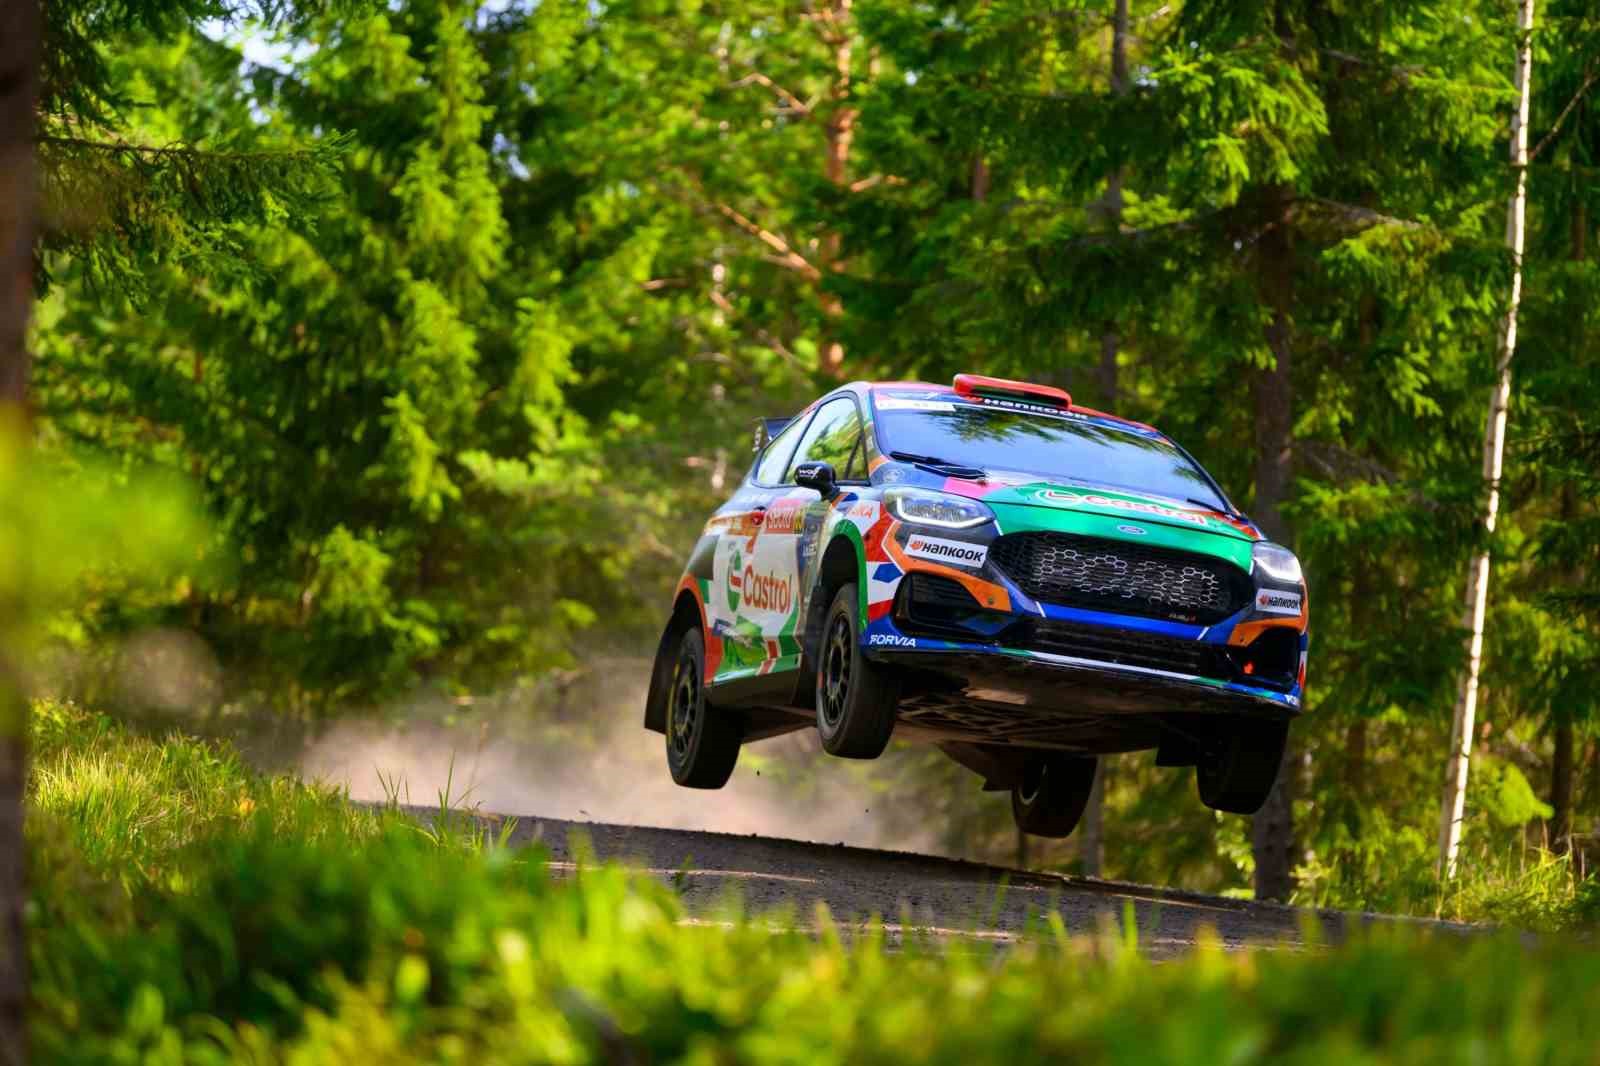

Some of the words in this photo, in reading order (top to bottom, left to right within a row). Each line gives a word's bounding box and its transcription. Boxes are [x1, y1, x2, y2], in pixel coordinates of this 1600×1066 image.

[1085, 494, 1209, 527] Castrol
[743, 563, 793, 615] Castrol
[869, 634, 917, 648] FORVIA
